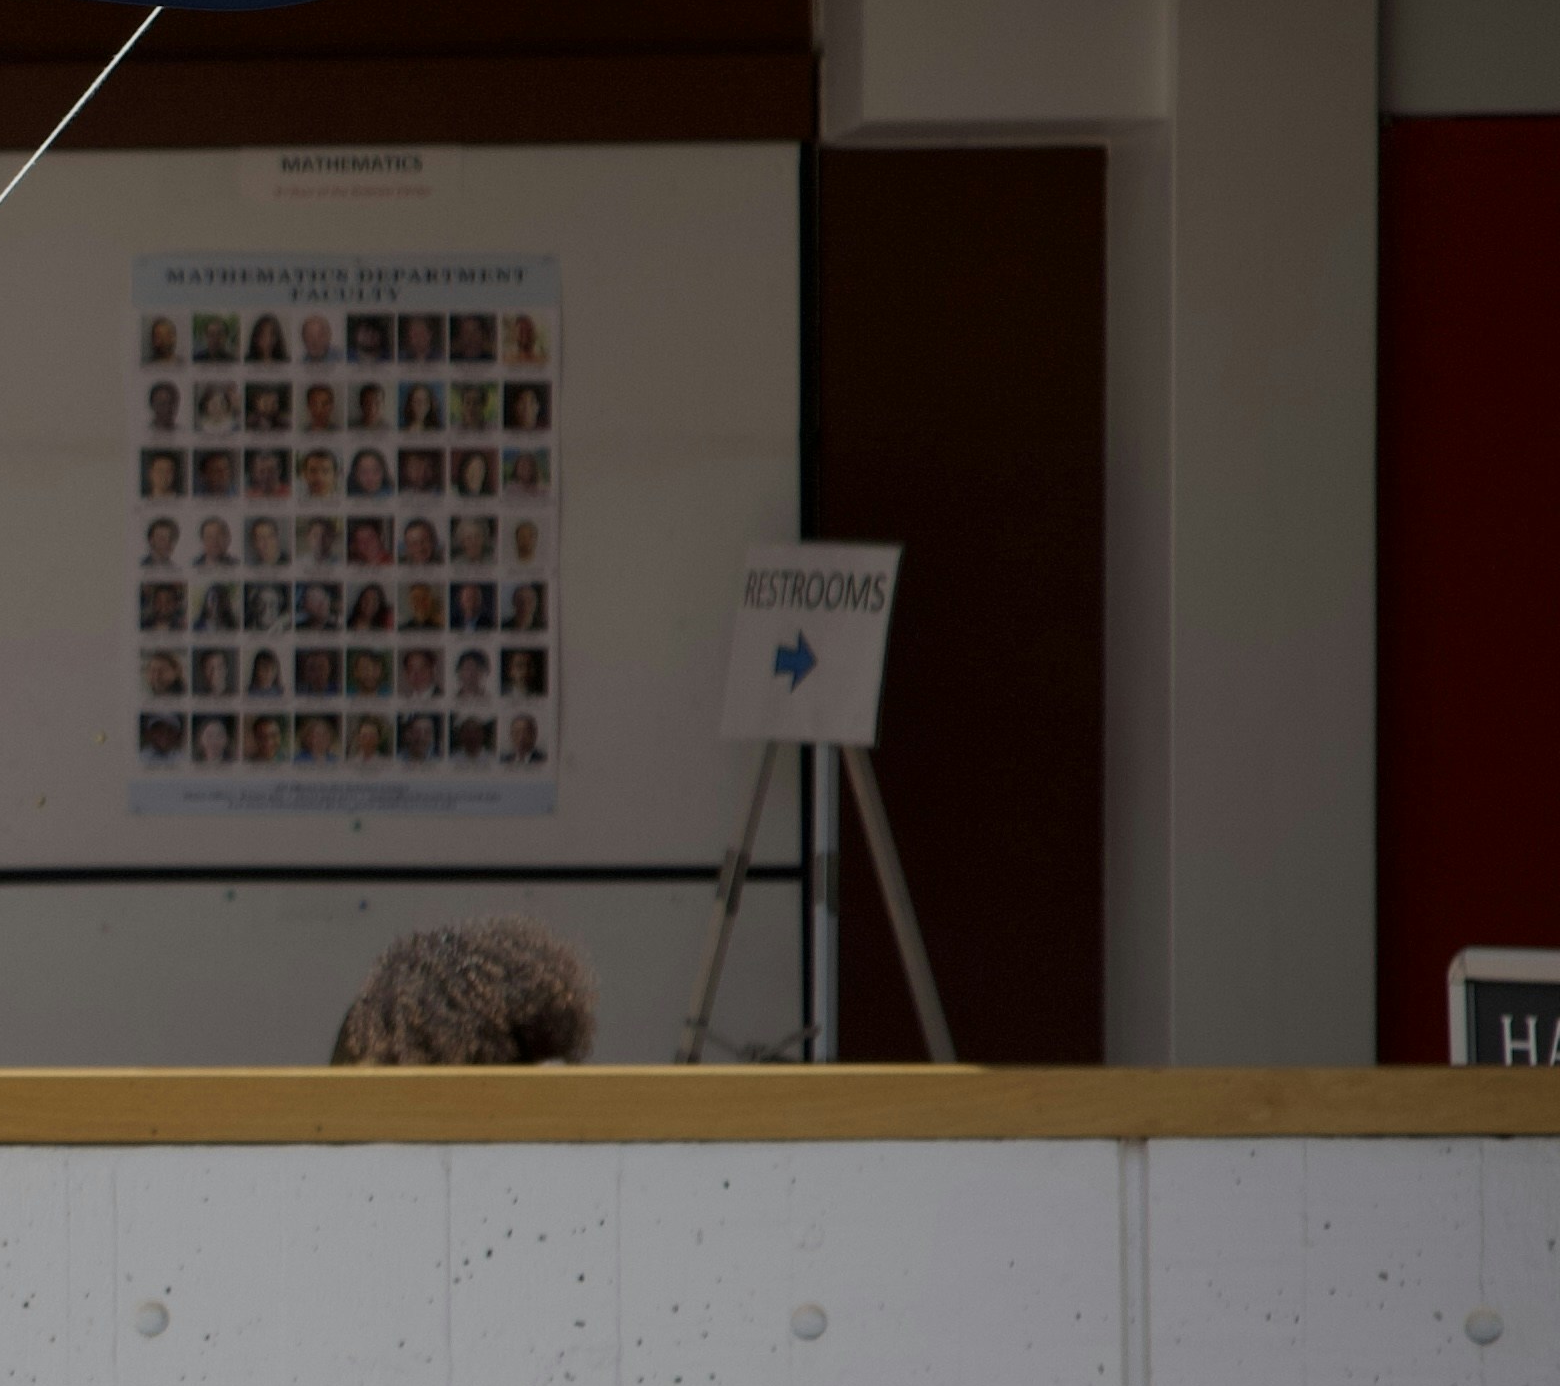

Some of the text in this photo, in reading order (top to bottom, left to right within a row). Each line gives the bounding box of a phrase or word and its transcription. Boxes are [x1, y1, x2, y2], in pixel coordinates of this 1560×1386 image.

[281, 154, 423, 173] MATHEMATICS
[165, 267, 526, 285] MATHEMATICS DEPARTMENT
[289, 286, 400, 304] FACULTY
[743, 569, 887, 613] RESTROOMS
